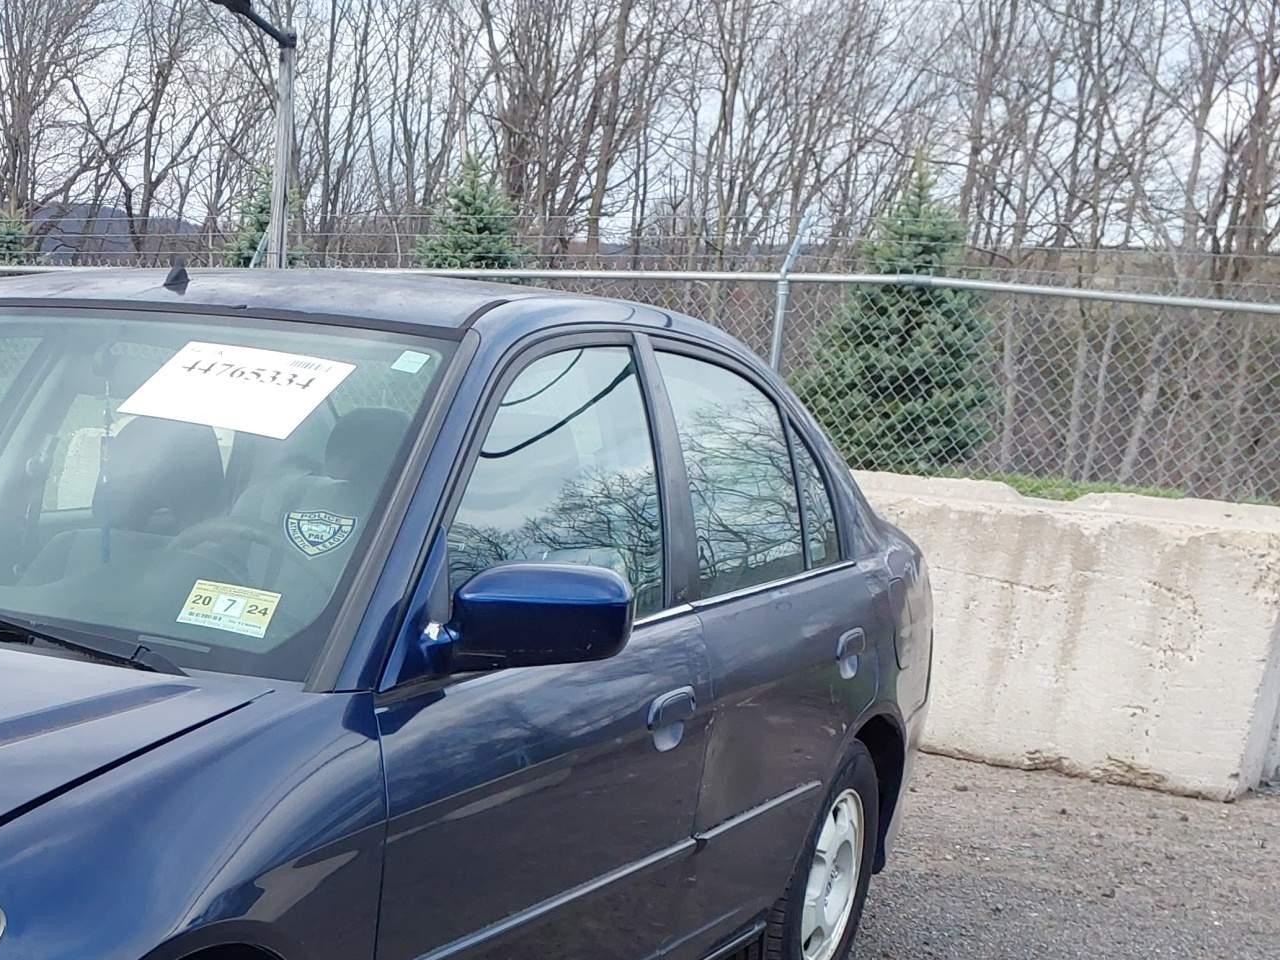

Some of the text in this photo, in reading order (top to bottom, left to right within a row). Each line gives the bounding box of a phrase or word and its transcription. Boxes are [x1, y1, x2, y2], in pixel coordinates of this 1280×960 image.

[182, 360, 316, 389] 44765334
[300, 513, 341, 523] POLICE
[290, 521, 310, 549] ATHLETIC
[308, 533, 324, 541] PAL
[316, 528, 349, 551] LEAGUE
[192, 594, 269, 616] 20 7 24
